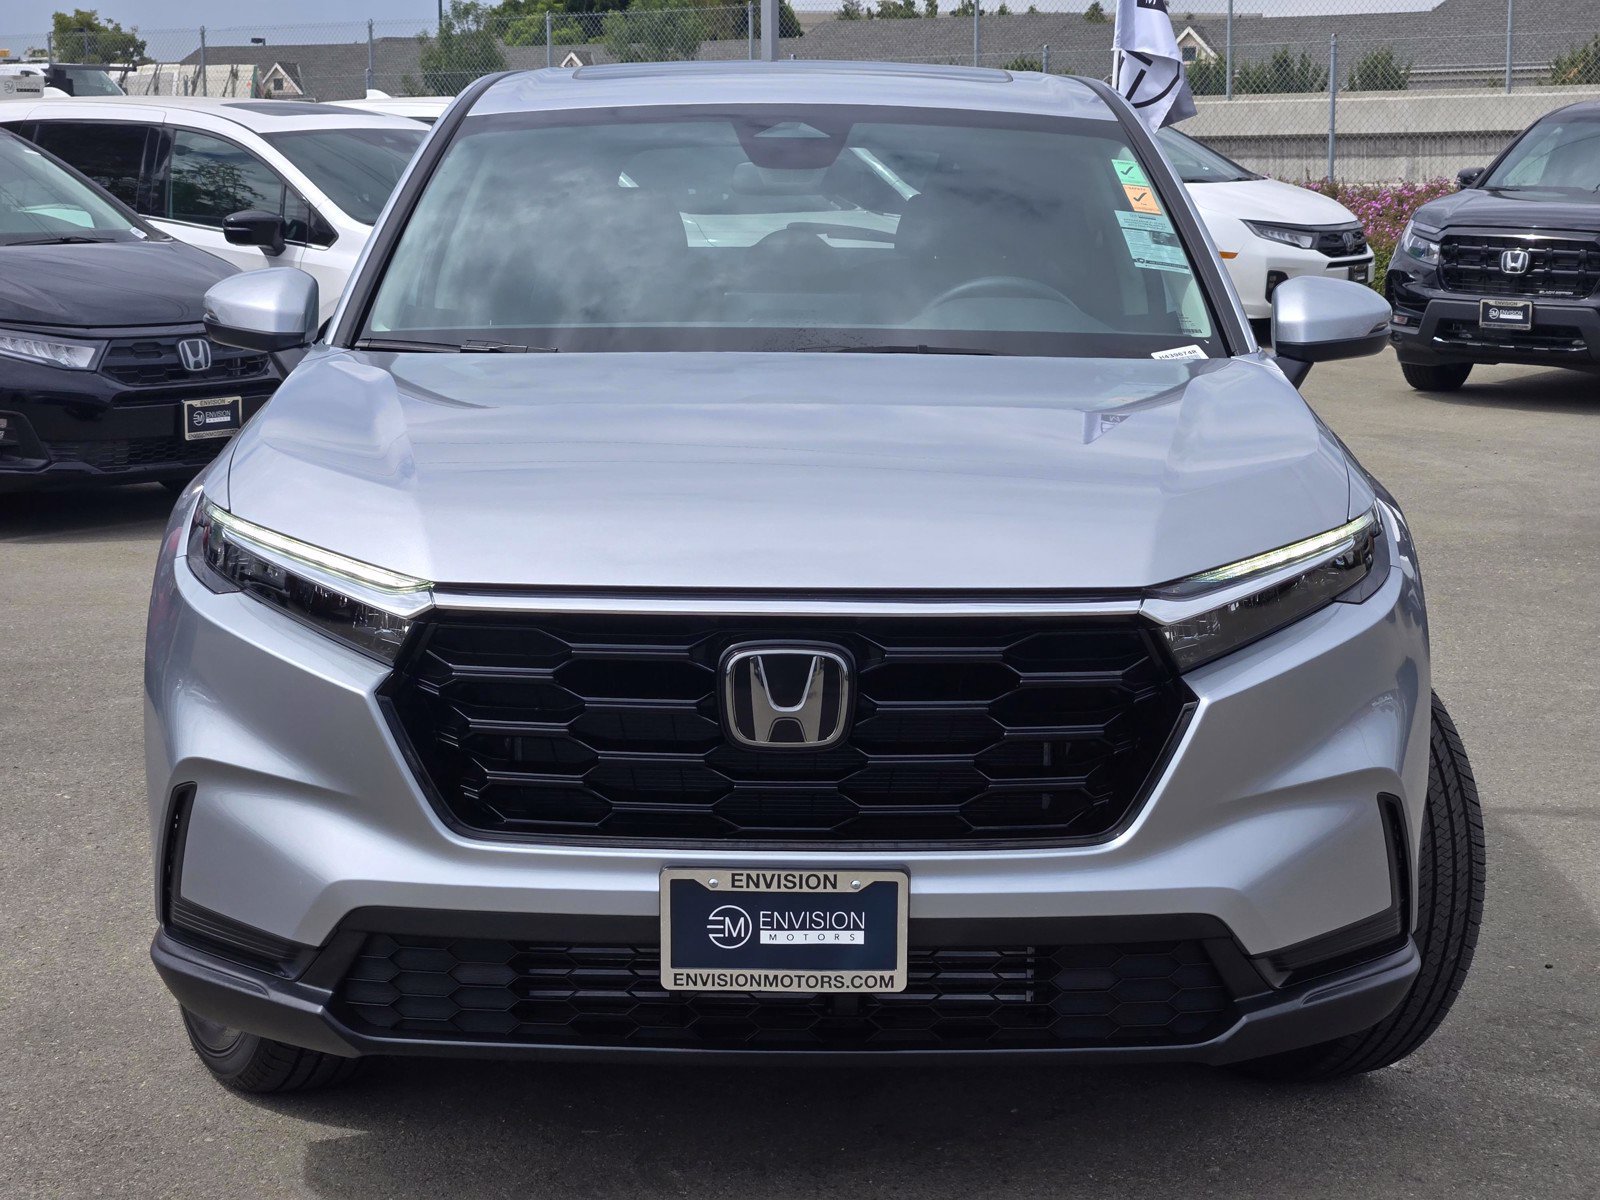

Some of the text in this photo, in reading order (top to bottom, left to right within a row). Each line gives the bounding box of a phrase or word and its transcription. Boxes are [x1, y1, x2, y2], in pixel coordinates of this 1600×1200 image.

[730, 873, 838, 890] ENVISION
[760, 911, 865, 930] ENVISION
[768, 933, 856, 942] MOTORS
[673, 972, 895, 989] ENVISIONMOTORS.COM
